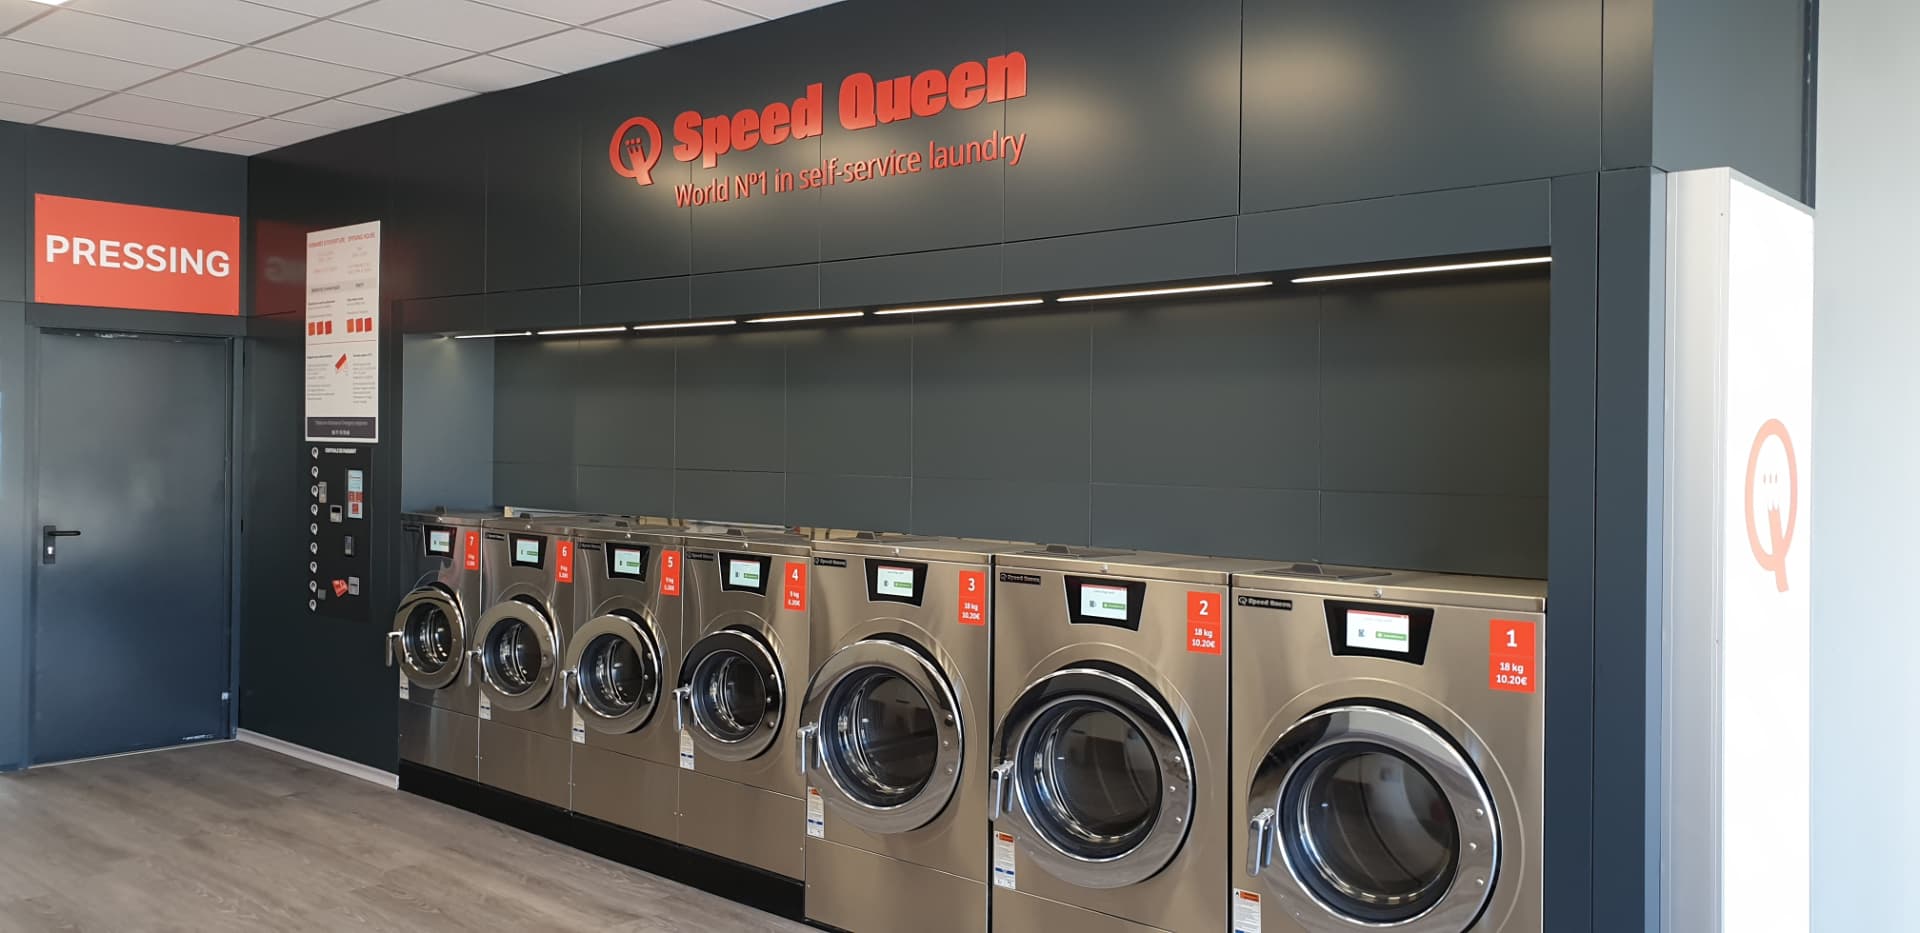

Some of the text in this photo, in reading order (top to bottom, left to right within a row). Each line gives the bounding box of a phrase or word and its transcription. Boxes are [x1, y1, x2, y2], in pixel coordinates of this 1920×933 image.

[673, 51, 1028, 169] Speed Queen
[674, 173, 729, 208] World
[774, 168, 794, 193] in
[799, 150, 921, 190] self-service
[929, 131, 1027, 170] laundry
[46, 234, 230, 278] PRESSING
[562, 546, 568, 557] 6
[667, 556, 673, 568] 5
[791, 568, 799, 581] 4
[967, 577, 976, 592] 3
[1199, 599, 1209, 616] 2
[1194, 627, 1214, 639] 18 kg
[1506, 629, 1518, 648] 1
[1191, 638, 1217, 649] 10.20€
[1499, 661, 1525, 675] 18 kg
[1495, 674, 1528, 687] 10.20€
